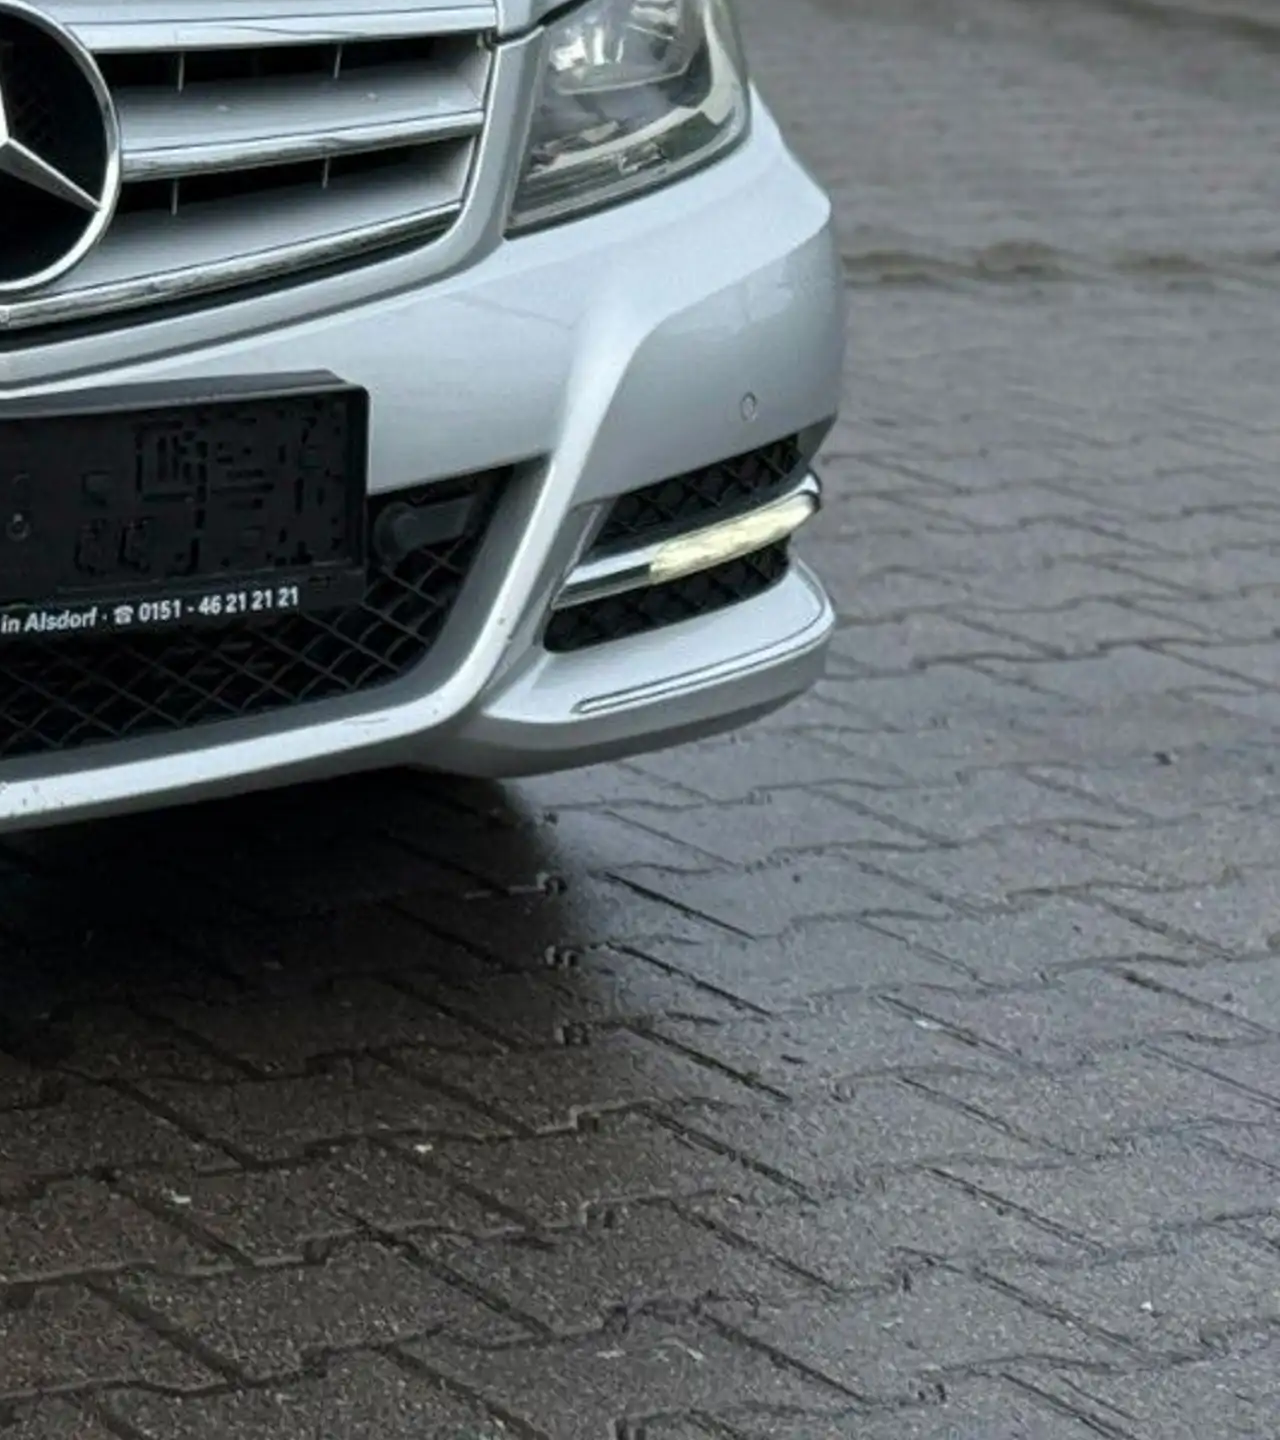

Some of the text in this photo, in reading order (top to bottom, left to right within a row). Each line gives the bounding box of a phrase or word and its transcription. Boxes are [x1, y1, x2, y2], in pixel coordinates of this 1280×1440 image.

[1, 614, 20, 634] in
[24, 606, 98, 632] Alsdorf
[138, 599, 181, 623] 0151
[198, 595, 222, 615] 46
[225, 592, 246, 613] 21
[251, 590, 272, 611] 21
[278, 586, 299, 607] 21
